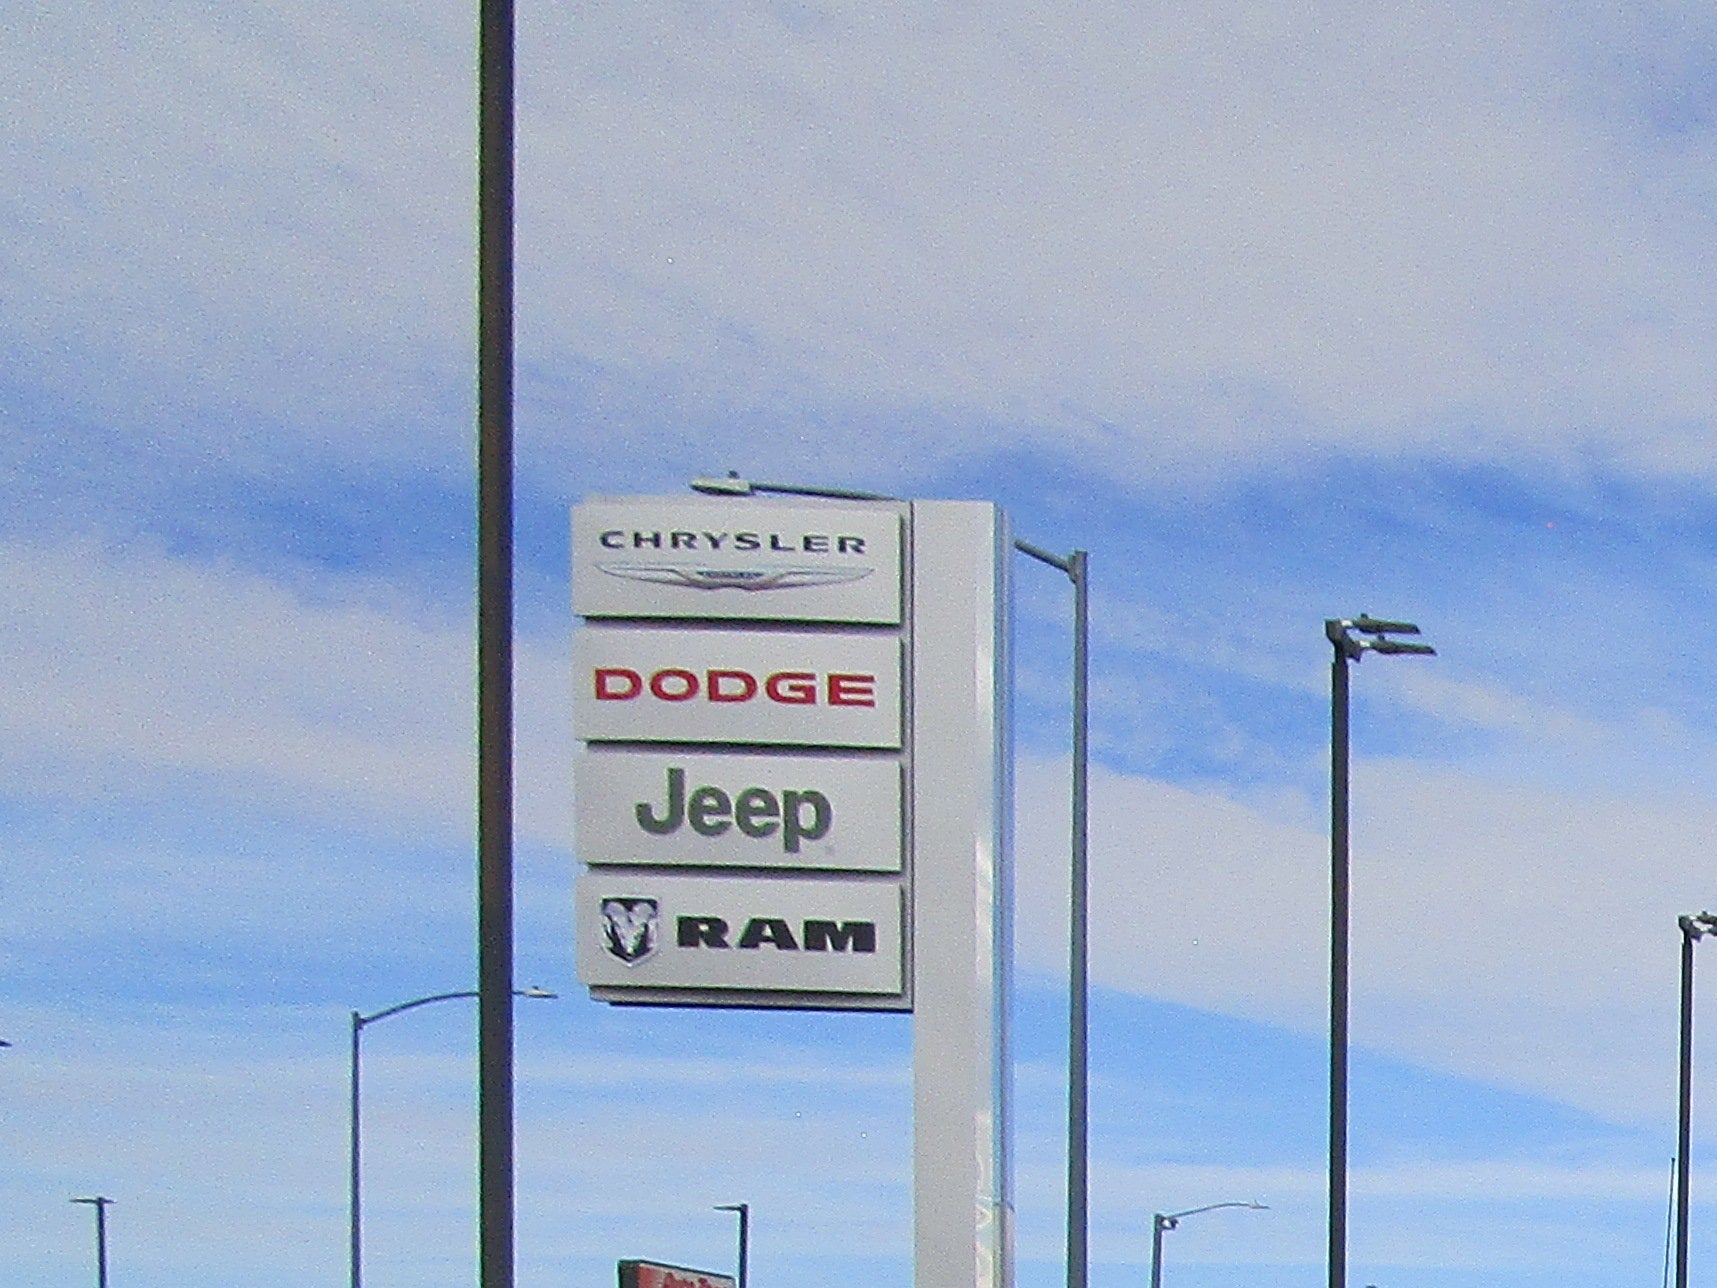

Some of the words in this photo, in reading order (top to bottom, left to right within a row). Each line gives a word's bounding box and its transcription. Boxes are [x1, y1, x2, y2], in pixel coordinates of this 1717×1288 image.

[600, 531, 867, 554] CHRYSLER
[595, 668, 876, 708] DODGE
[635, 768, 833, 853] Jeep
[676, 916, 877, 953] RAM
